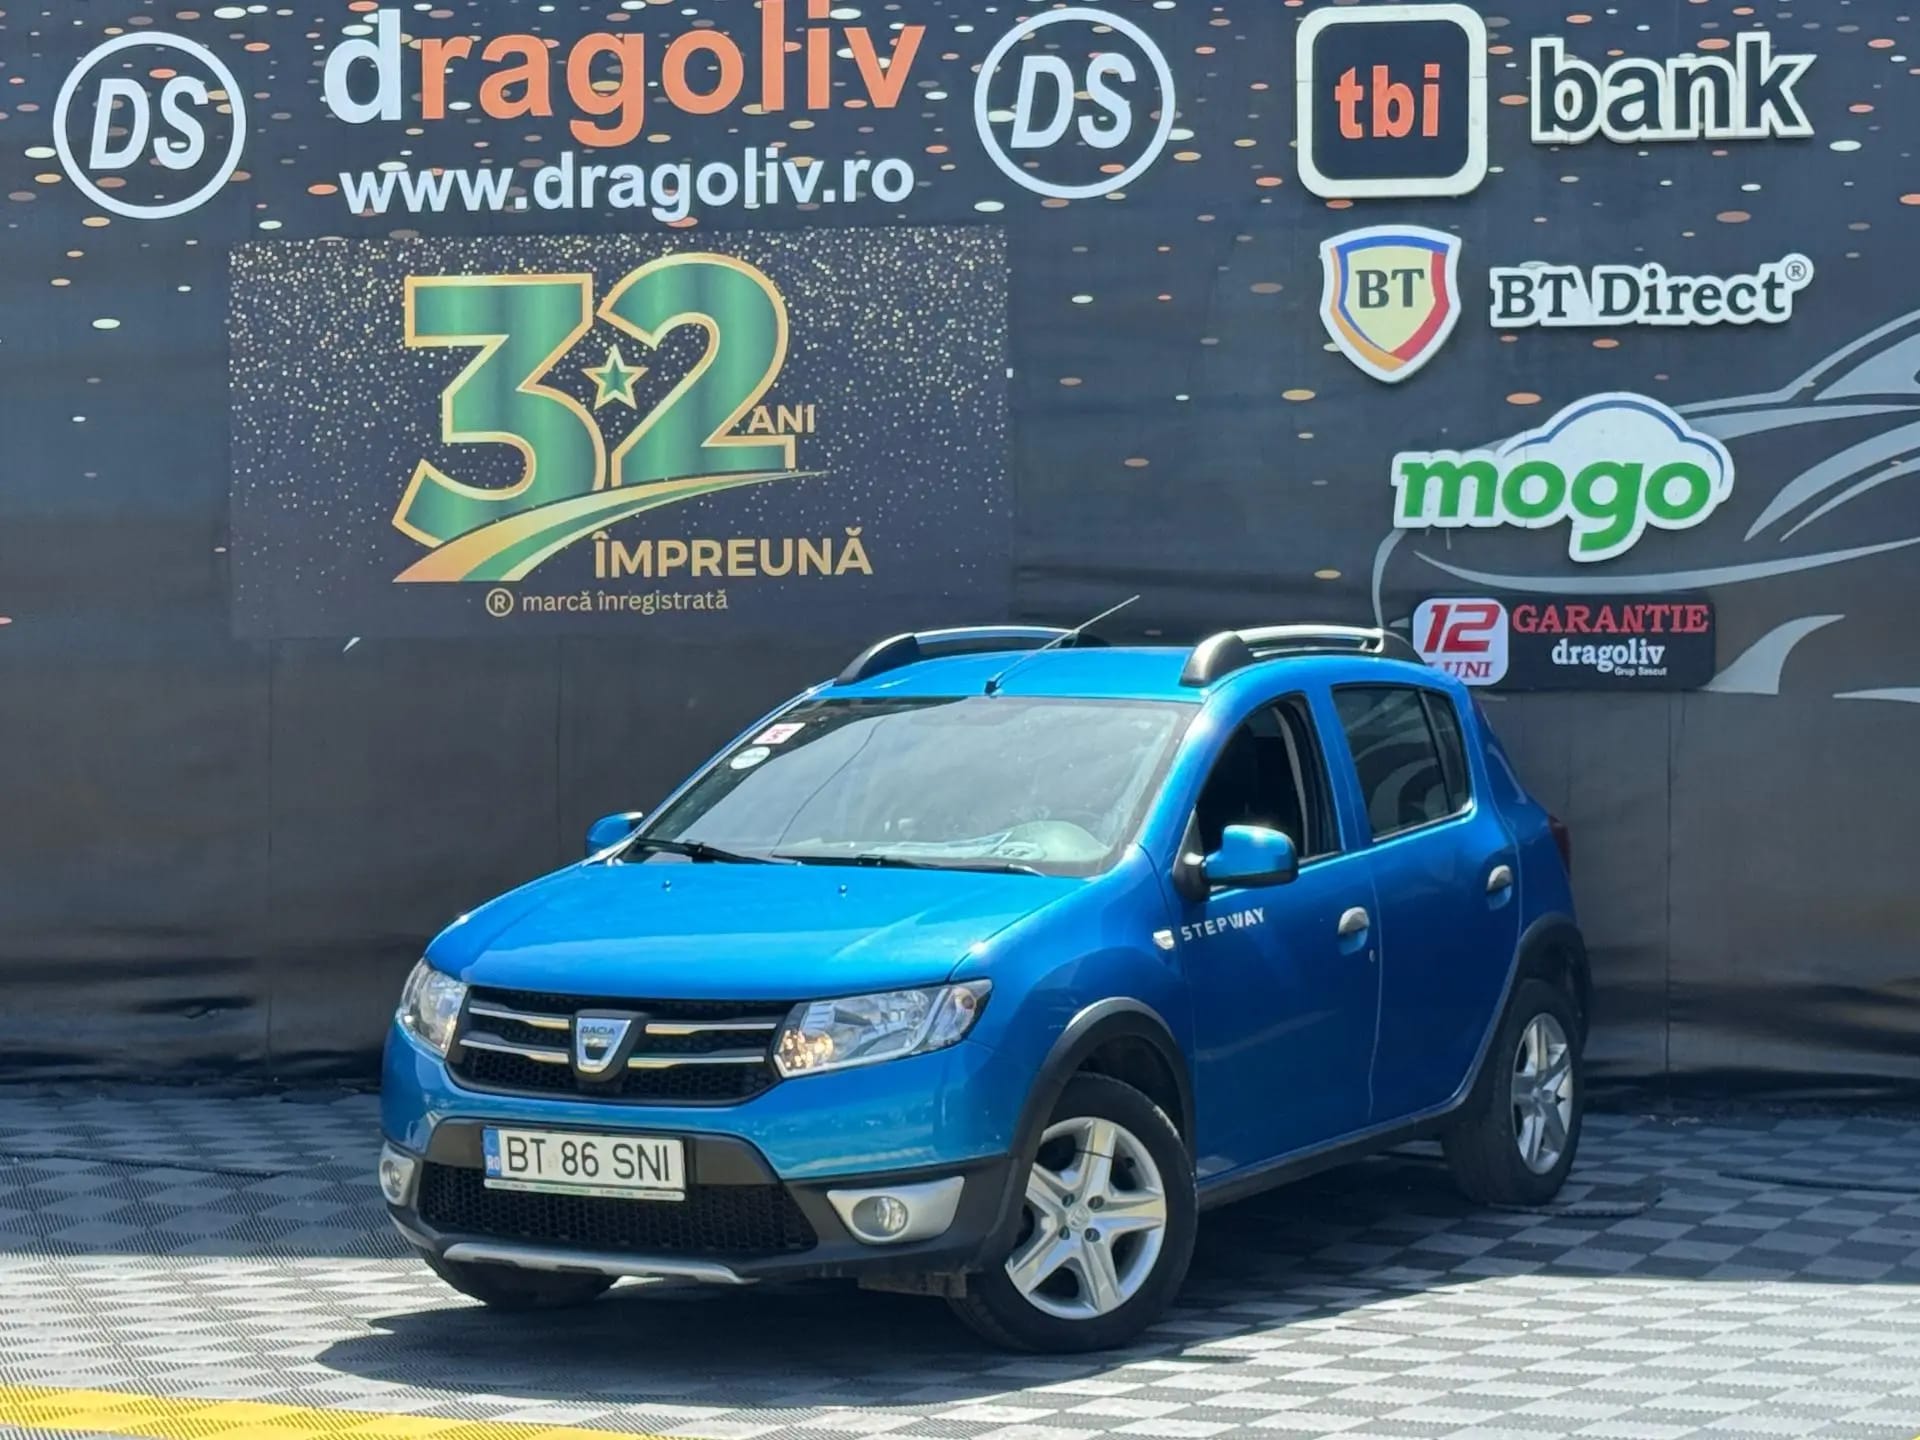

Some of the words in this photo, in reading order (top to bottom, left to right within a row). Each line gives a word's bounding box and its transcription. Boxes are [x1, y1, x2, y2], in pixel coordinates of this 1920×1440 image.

[324, 0, 926, 146] dragoliv
[1536, 38, 1811, 138] bank
[89, 76, 209, 170] DS
[1010, 52, 1137, 149] DS
[1334, 63, 1441, 139] tbi
[340, 147, 915, 222] www.dragoliv.ro
[1356, 267, 1425, 309] BT
[1497, 271, 1578, 319] BT
[392, 252, 796, 549] 32
[748, 405, 816, 433] ANI
[1400, 459, 1711, 552] mogo
[594, 527, 873, 579] ÎMPREUNĂ
[522, 591, 593, 612] marcă
[597, 589, 728, 616] înregistrată
[1424, 603, 1500, 653] 12
[1512, 604, 1710, 634] GARANTIE
[1551, 638, 1666, 673] dragoliv
[1181, 907, 1265, 941] STEPWAY
[582, 1025, 616, 1036] DACIA
[507, 1136, 546, 1174] BT
[561, 1140, 599, 1177] 86
[612, 1143, 670, 1182] SNI
